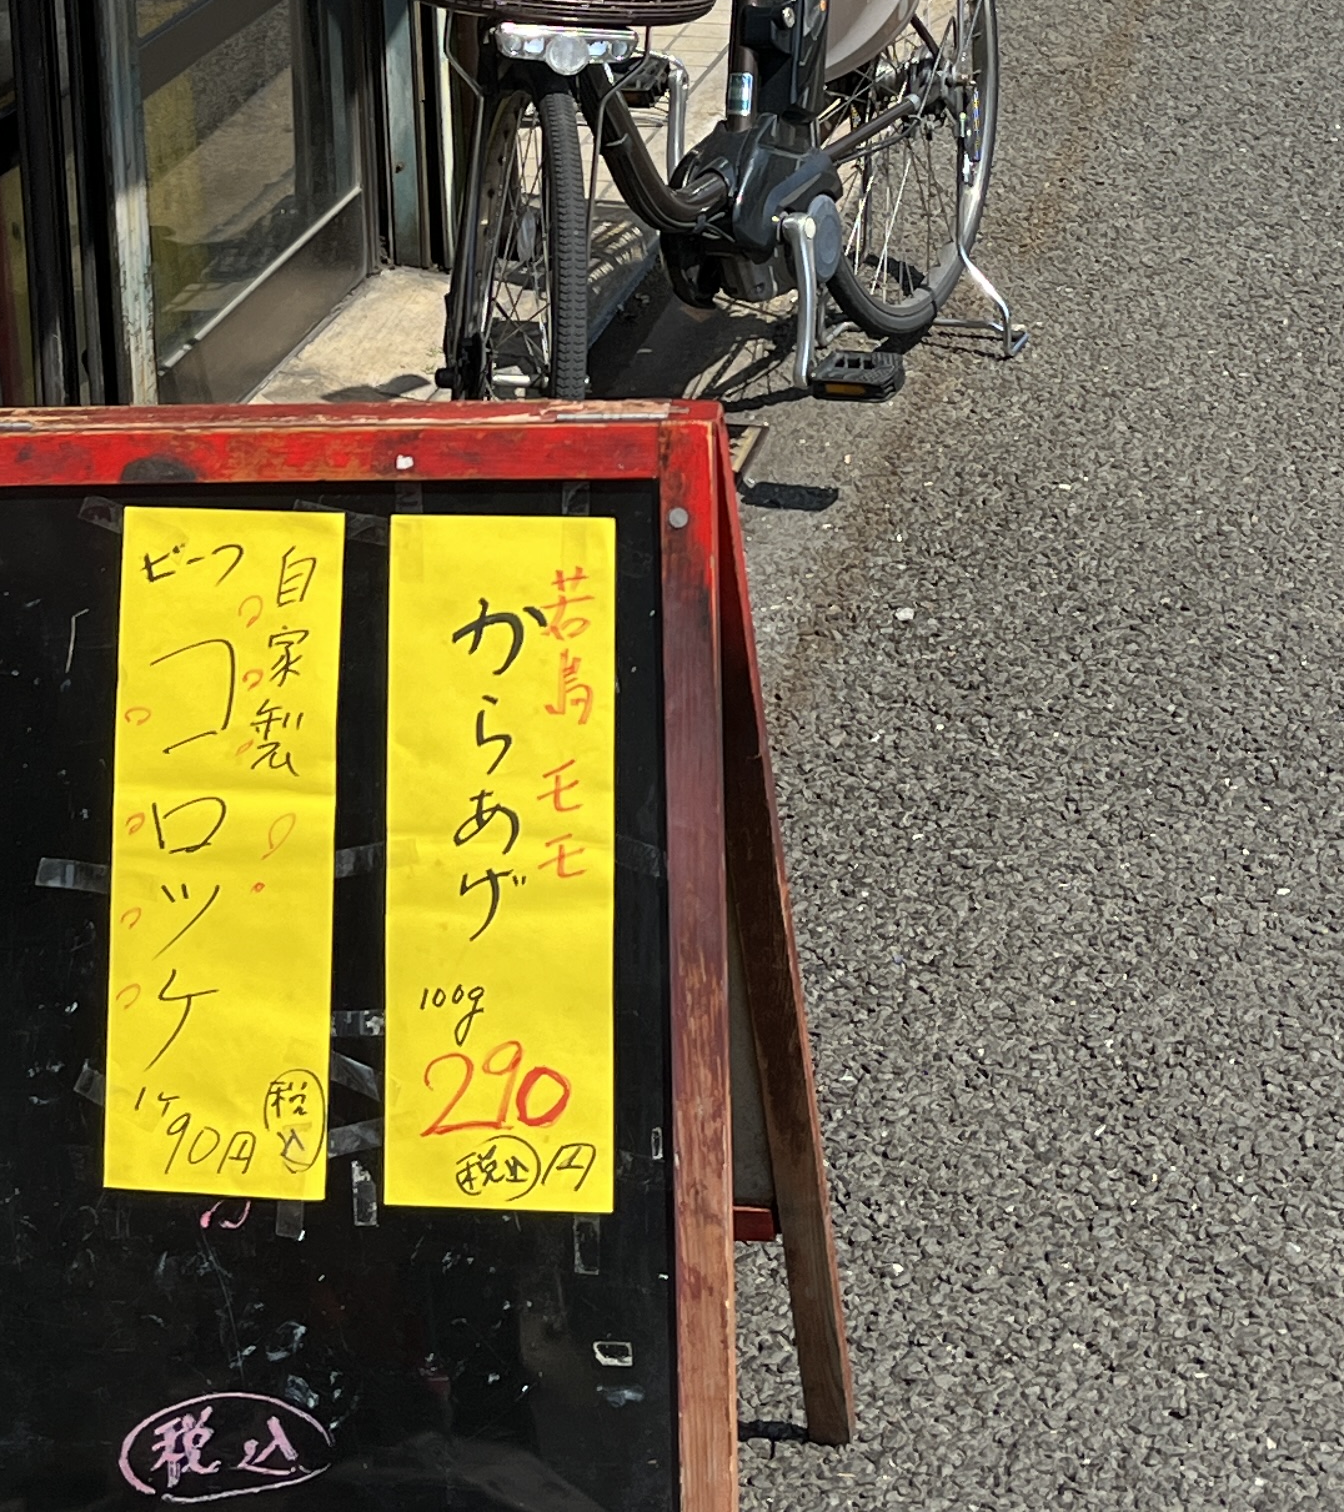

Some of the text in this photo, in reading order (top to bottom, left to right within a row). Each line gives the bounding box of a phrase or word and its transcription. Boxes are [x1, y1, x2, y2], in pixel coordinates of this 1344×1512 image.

[140, 542, 245, 587] ビーフ
[249, 544, 317, 778] 自家製
[452, 596, 548, 942] からあげ
[418, 984, 485, 1047] 100g
[419, 1039, 571, 1138] 290
[163, 1112, 257, 1175] 90円
[148, 1406, 302, 1489] 税込
